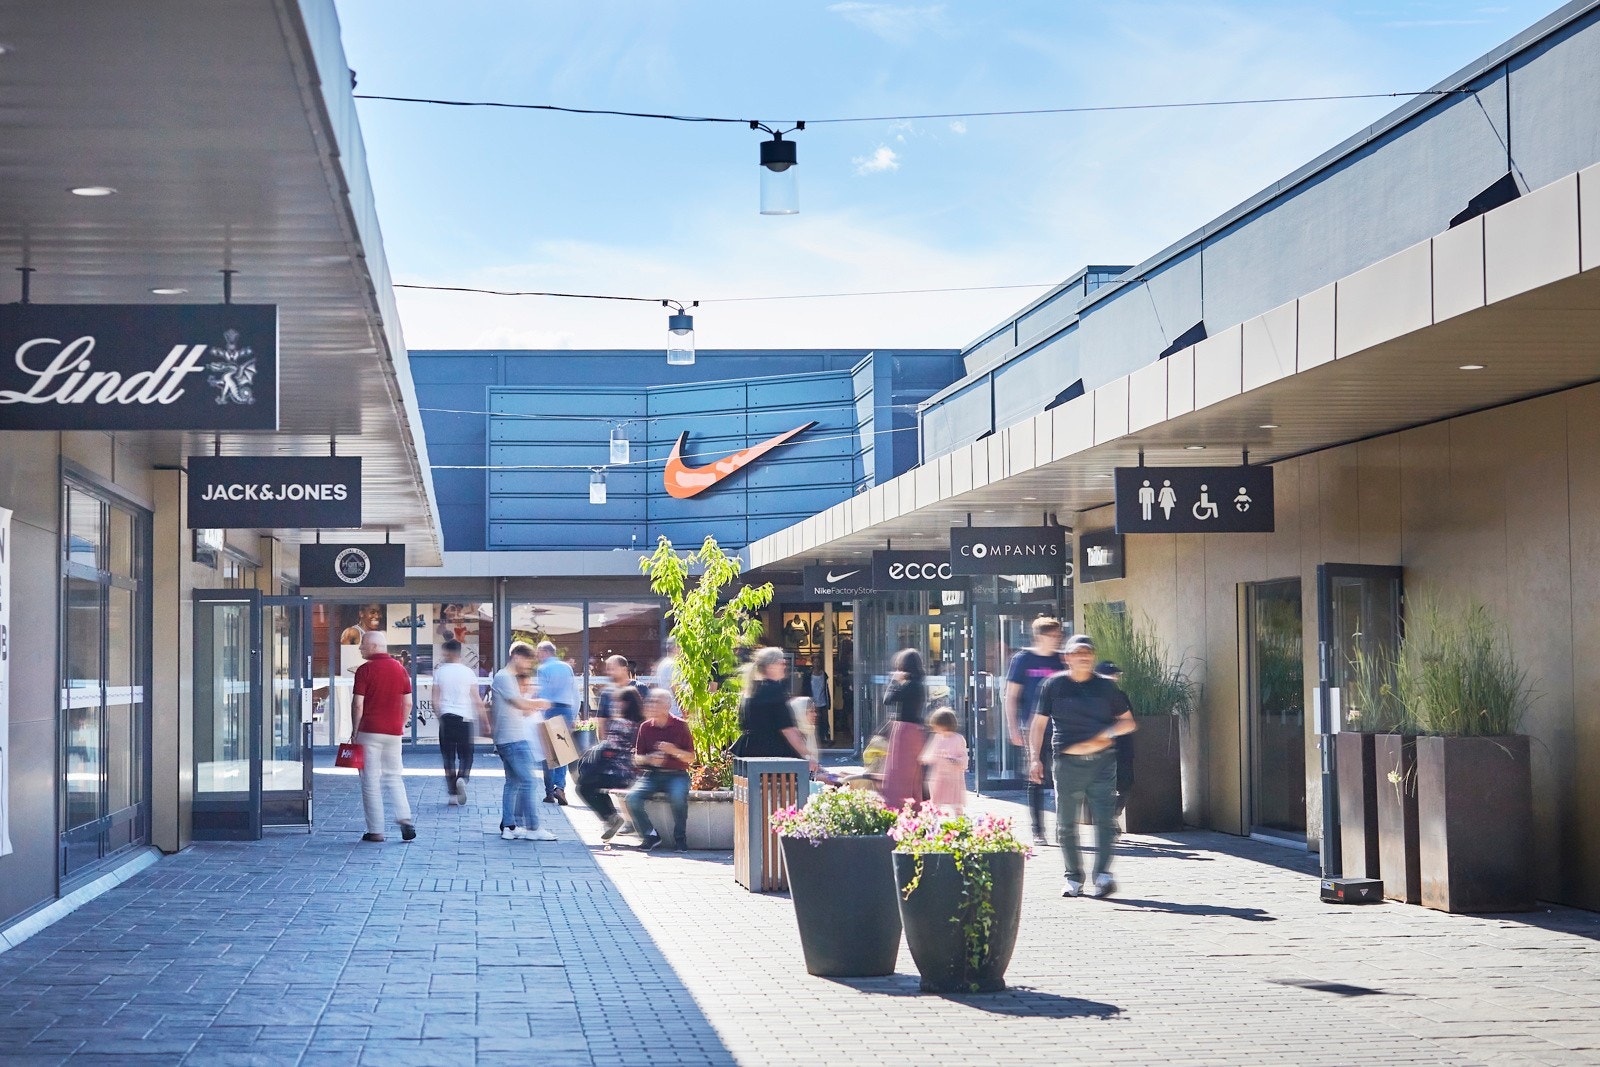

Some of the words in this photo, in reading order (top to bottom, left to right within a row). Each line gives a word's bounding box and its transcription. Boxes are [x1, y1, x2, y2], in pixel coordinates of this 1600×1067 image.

[0, 336, 207, 404] Lindt
[201, 484, 347, 501] JACK&JONES
[960, 543, 1057, 558] COMPANYS
[888, 562, 951, 580] ecco
